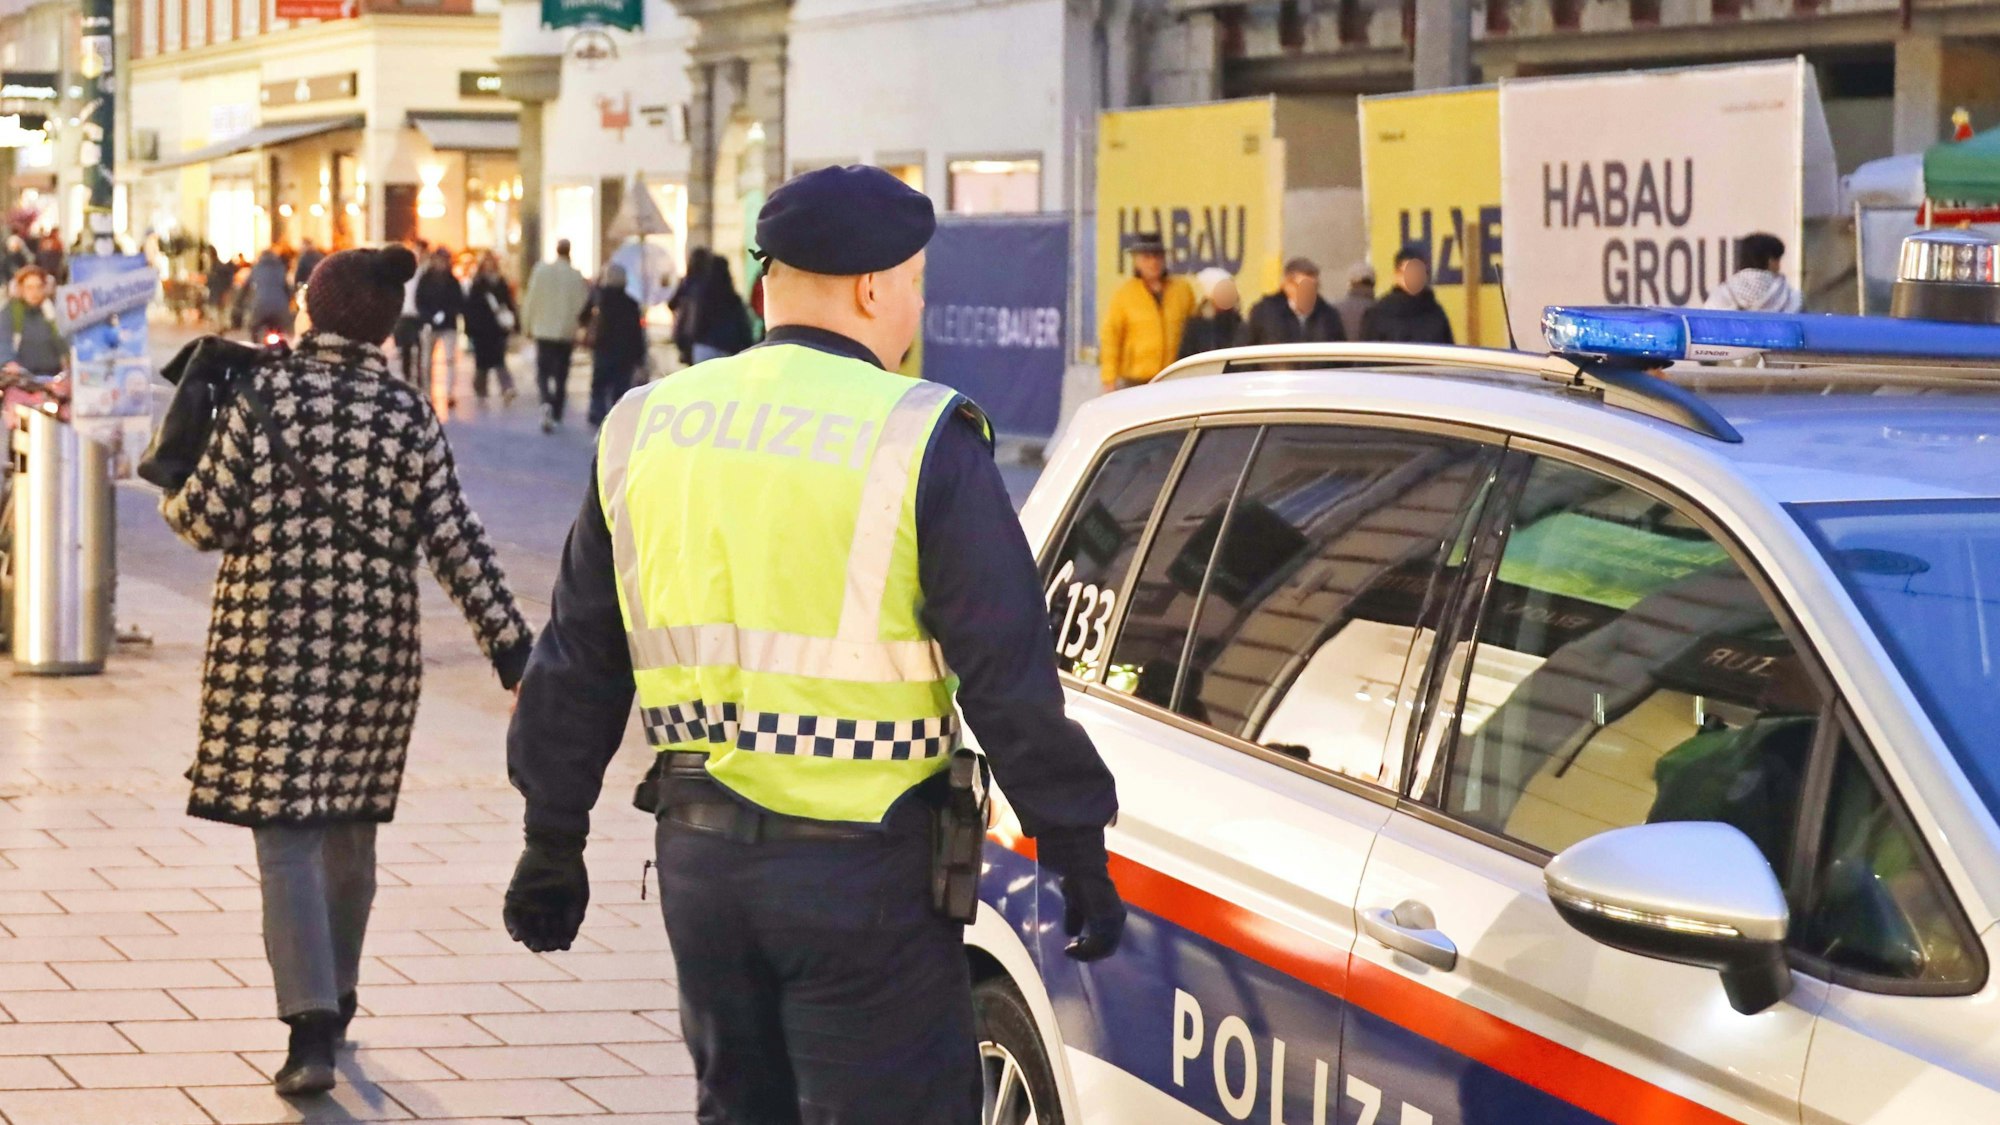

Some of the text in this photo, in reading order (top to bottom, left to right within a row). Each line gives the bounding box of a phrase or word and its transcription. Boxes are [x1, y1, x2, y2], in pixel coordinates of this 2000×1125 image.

[1542, 158, 1694, 228] HABAU
[636, 400, 875, 470] POLIZEI
[1056, 581, 1116, 662] 133
[1173, 988, 1433, 1125] POLIZ
